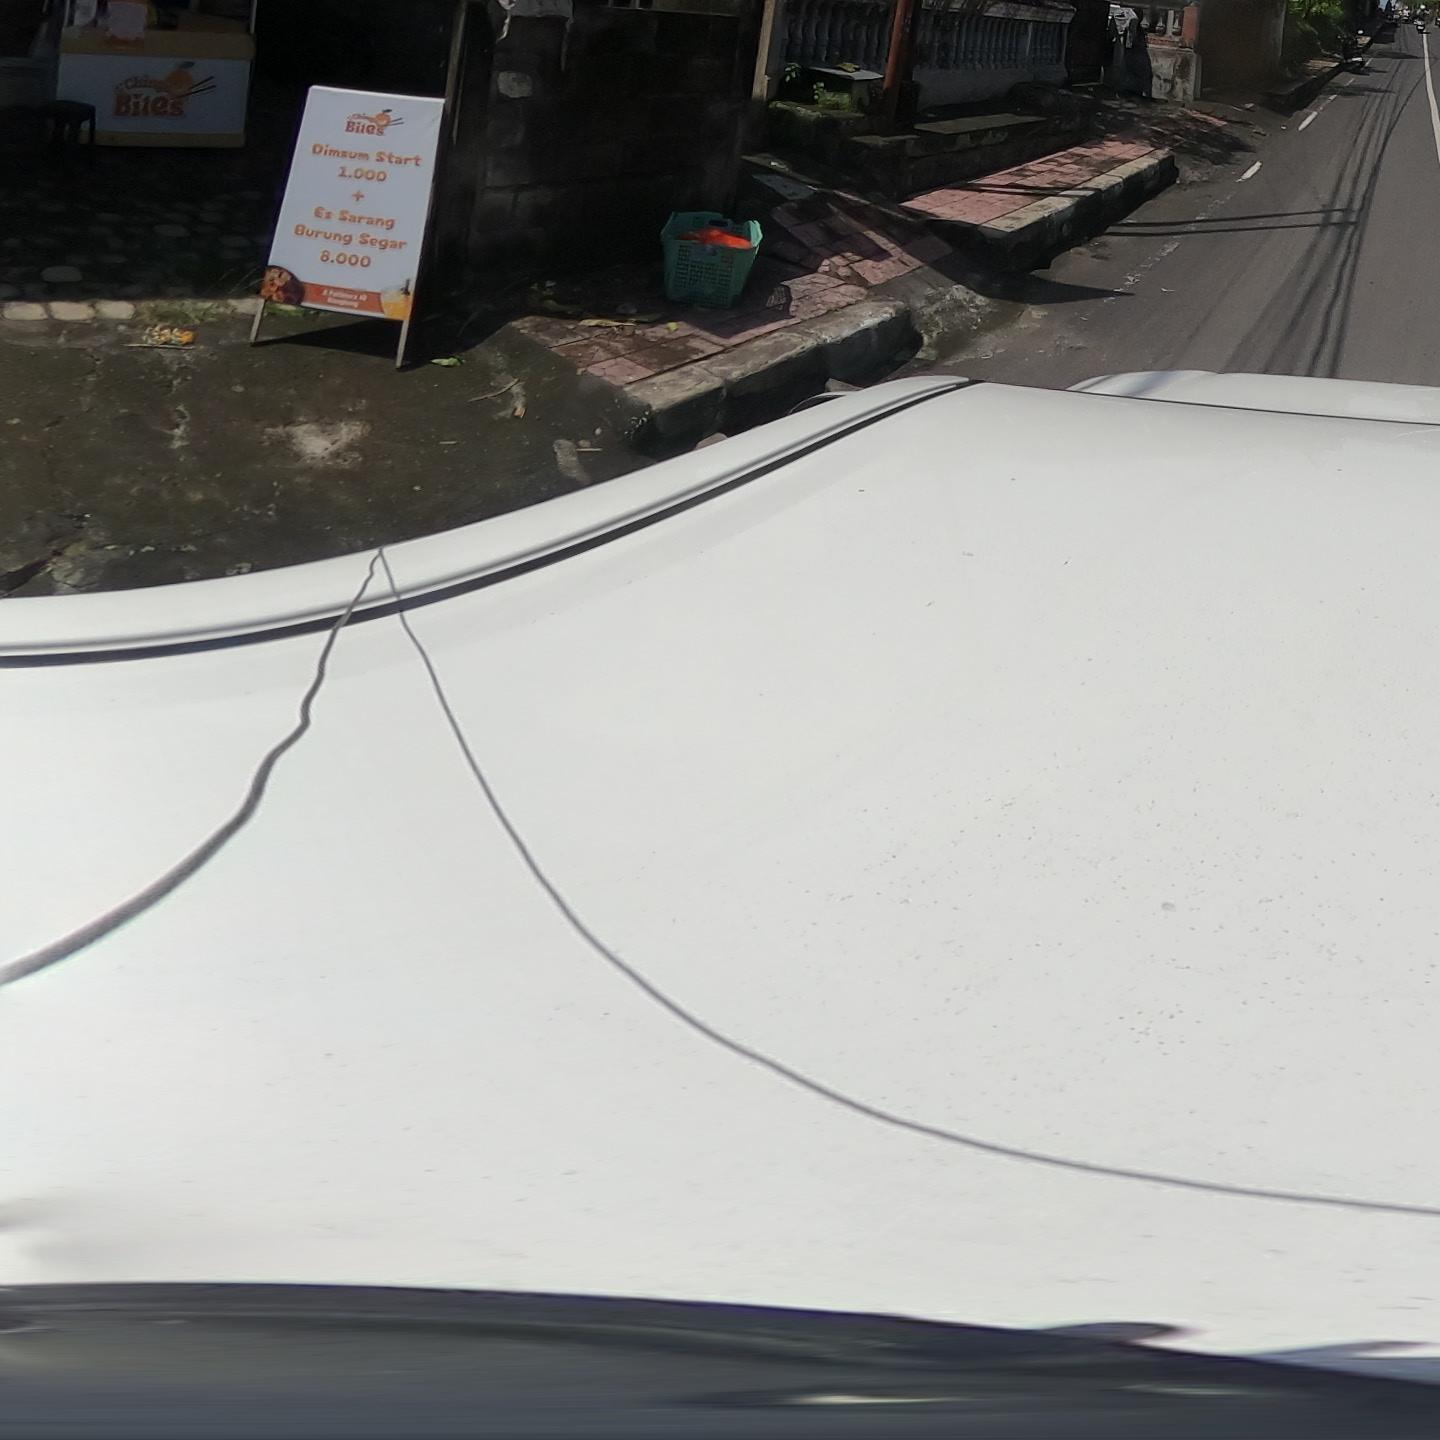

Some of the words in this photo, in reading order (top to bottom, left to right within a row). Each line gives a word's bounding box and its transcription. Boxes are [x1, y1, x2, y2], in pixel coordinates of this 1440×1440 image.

[112, 94, 186, 118] Bites
[344, 120, 386, 136] Bites
[311, 143, 370, 161] Dimsum
[375, 151, 423, 167] Start
[337, 166, 388, 183] 1.000
[313, 206, 333, 220] Es
[338, 210, 396, 231] Sarang
[293, 224, 354, 246] Burung
[358, 232, 408, 251] Segar
[319, 249, 372, 268] 8.000
